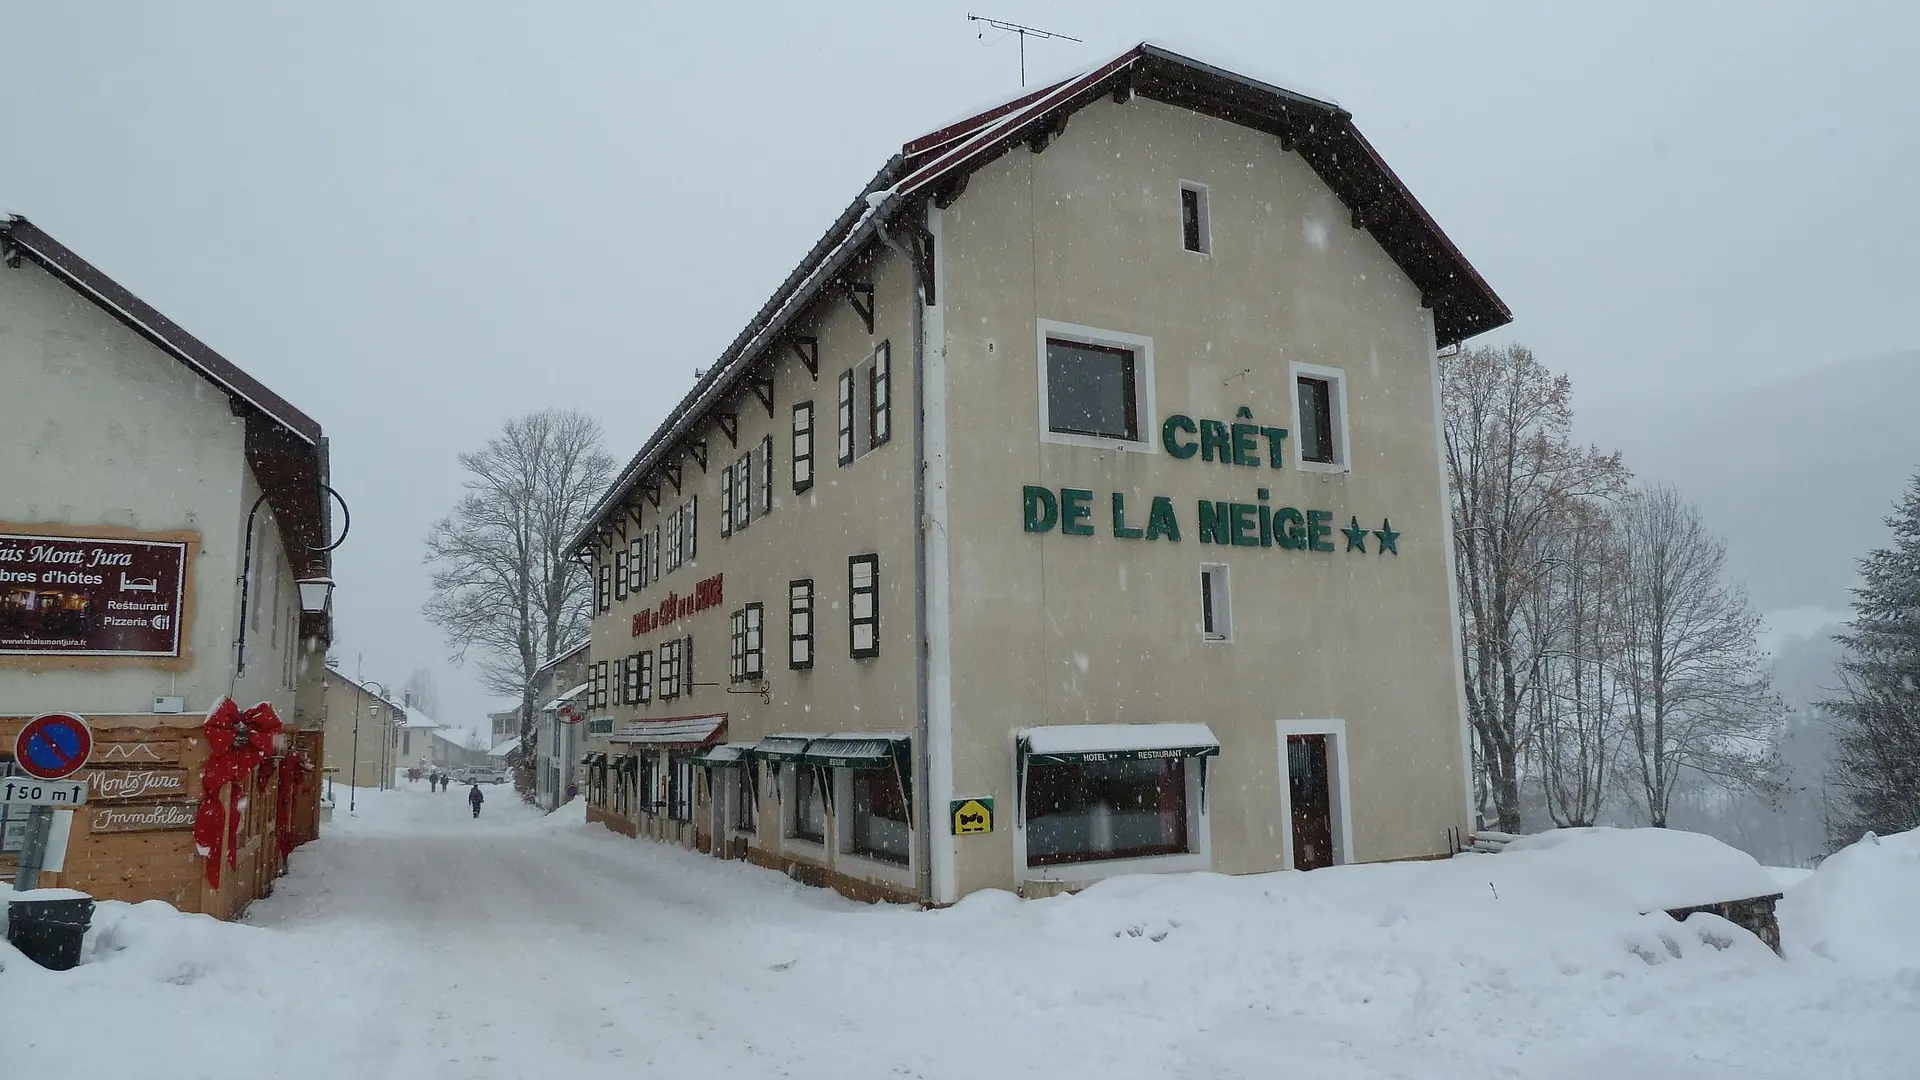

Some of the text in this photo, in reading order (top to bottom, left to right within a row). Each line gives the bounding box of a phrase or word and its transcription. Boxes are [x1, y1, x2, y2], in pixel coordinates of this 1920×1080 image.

[1163, 406, 1288, 469] CRÊT
[1023, 485, 1095, 535] DE
[1112, 492, 1181, 542] LA
[27, 545, 84, 564] Mont
[86, 548, 132, 568] Jura
[42, 570, 103, 585] d'hôtes
[107, 600, 168, 611] Restaurant
[104, 616, 148, 626] Pizzeria
[1083, 749, 1182, 762] HOTEL RESTAURANT
[18, 786, 67, 801] 50 m
[93, 805, 196, 829] Immobilier
